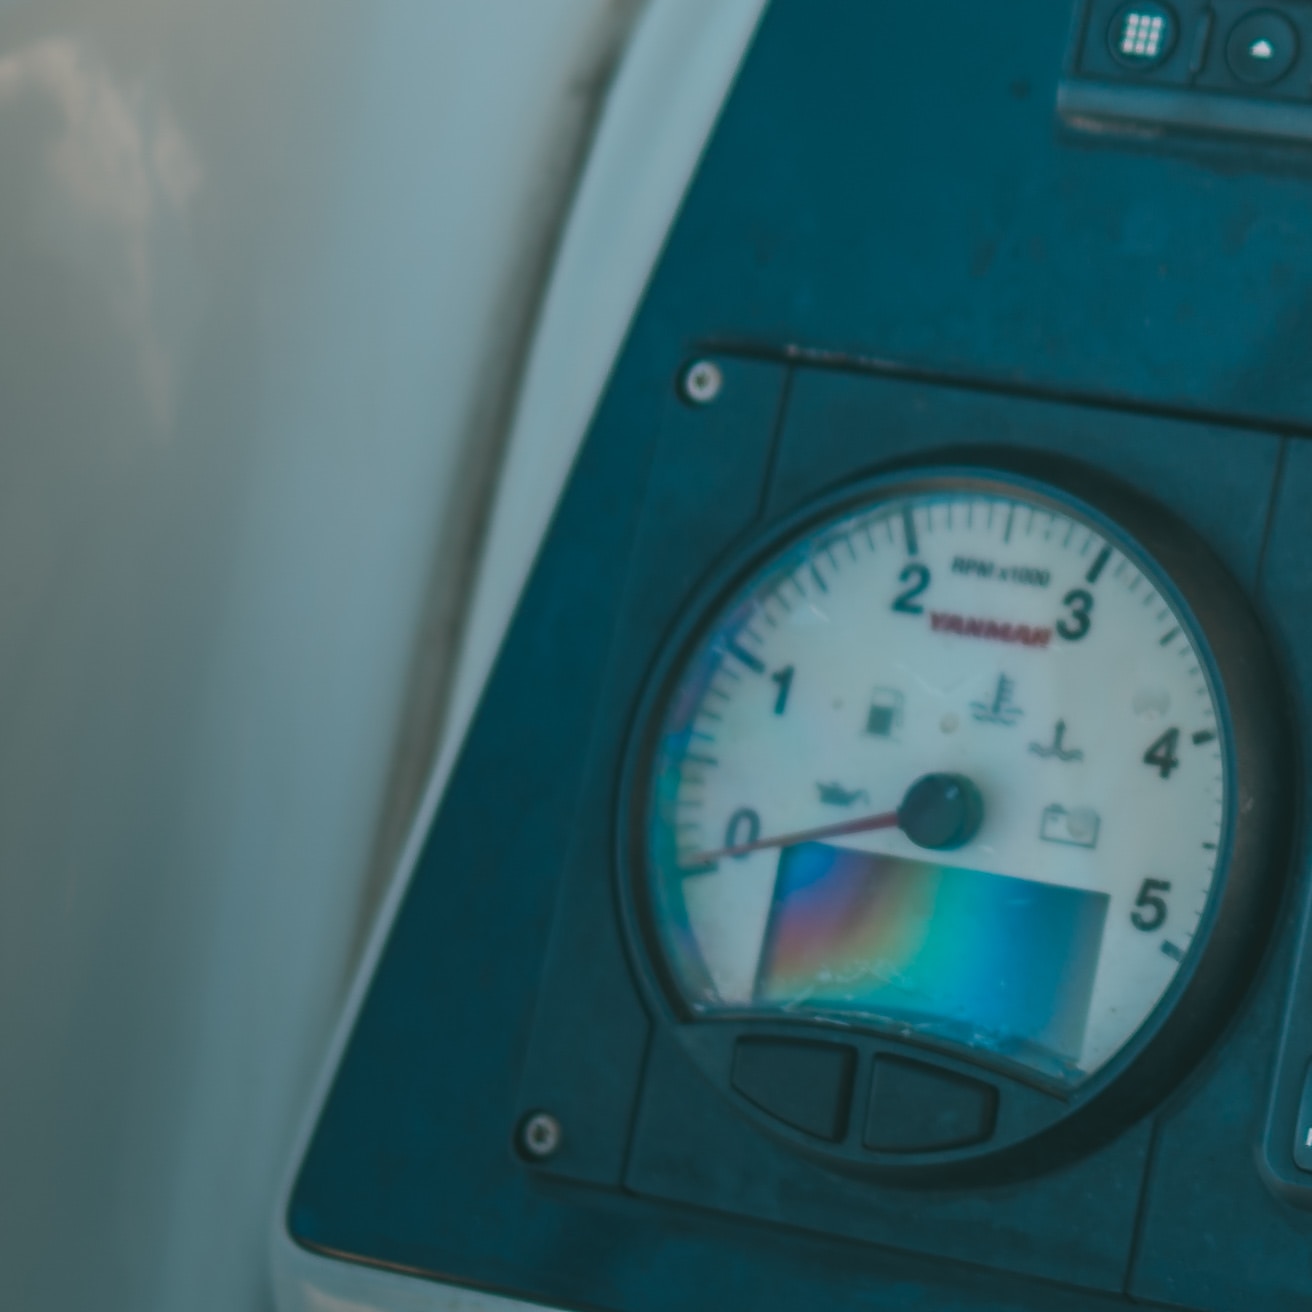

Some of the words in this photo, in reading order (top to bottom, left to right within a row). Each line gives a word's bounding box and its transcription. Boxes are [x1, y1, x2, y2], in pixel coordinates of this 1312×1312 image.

[892, 563, 930, 614] 2
[1056, 588, 1094, 641] 3
[771, 667, 795, 714] 1
[1143, 728, 1181, 778] 4
[725, 806, 761, 857] 0
[1131, 878, 1170, 930] 5
